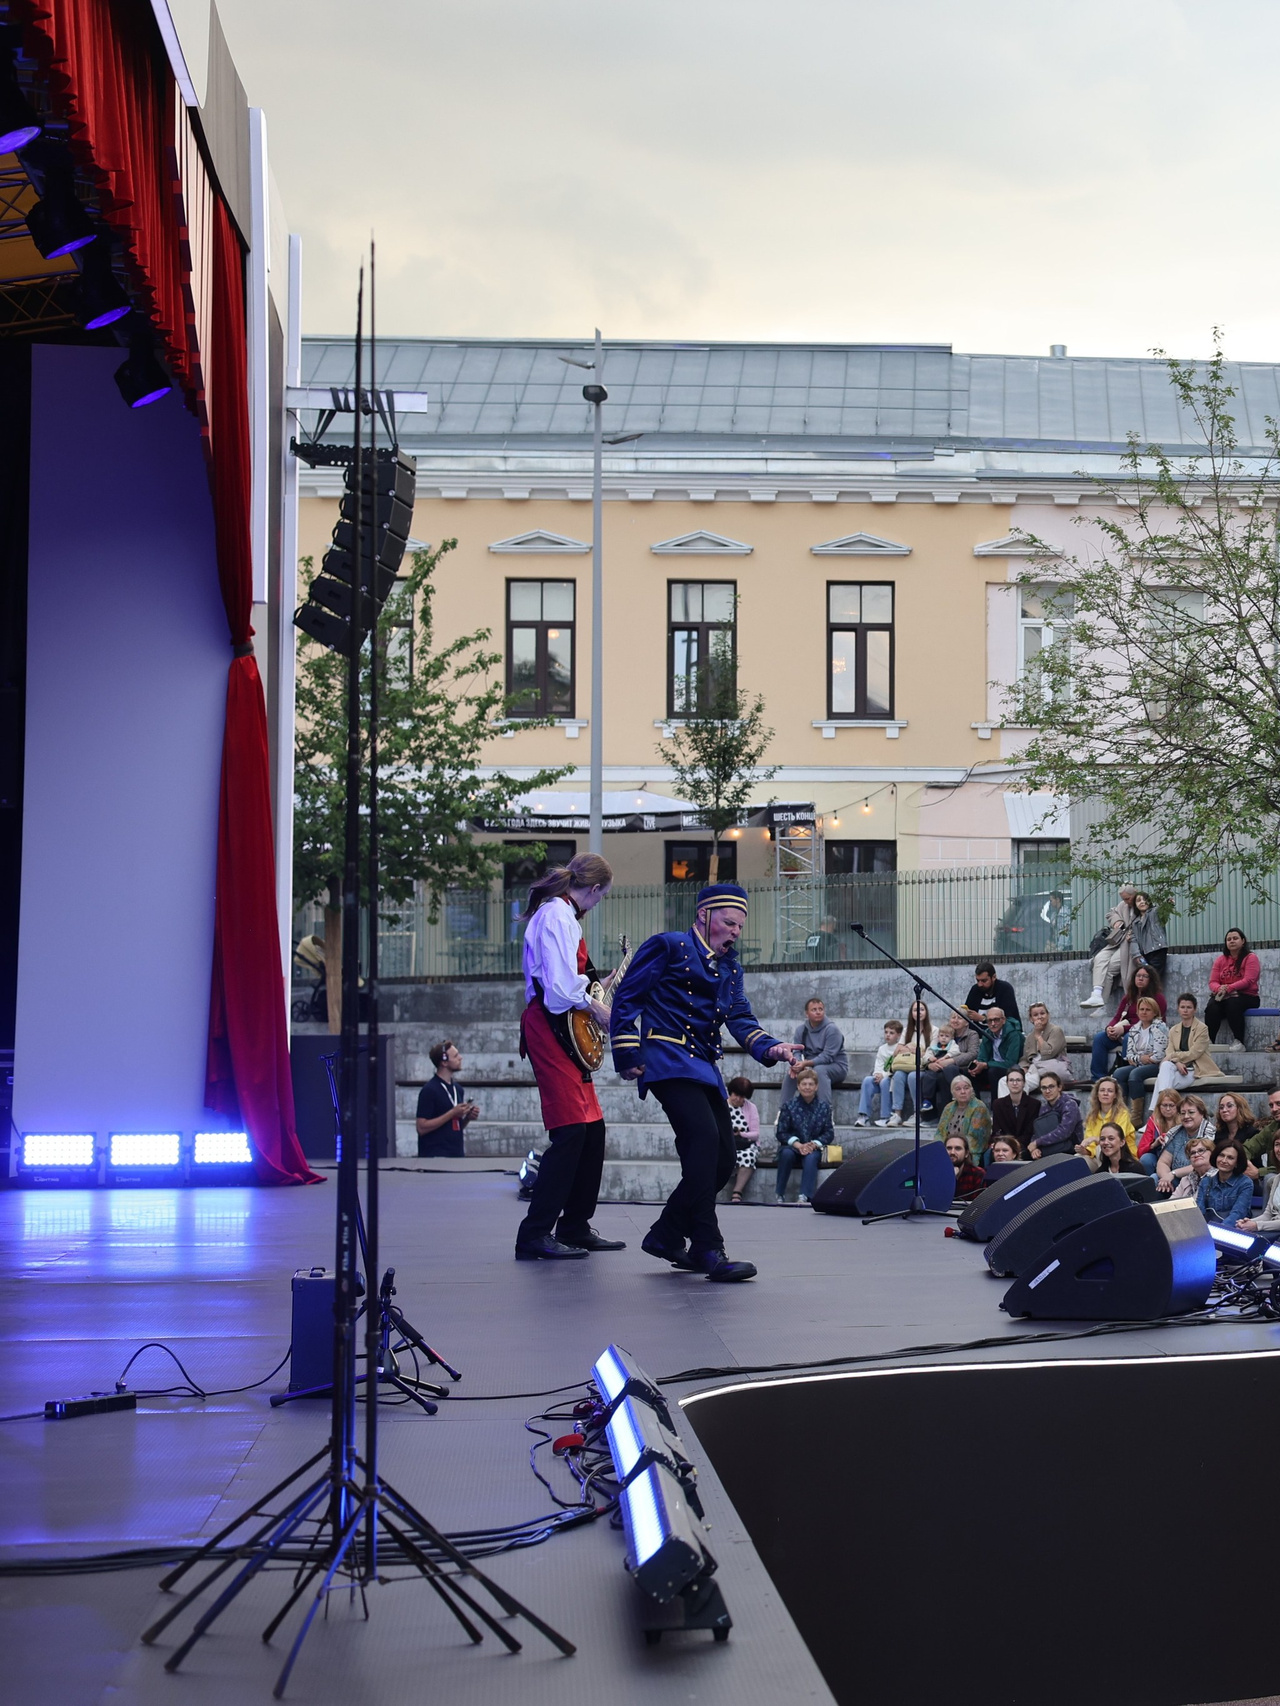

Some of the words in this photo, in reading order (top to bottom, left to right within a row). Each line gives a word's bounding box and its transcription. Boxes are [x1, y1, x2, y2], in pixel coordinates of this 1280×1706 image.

[773, 812, 796, 822] ШЕСТЬ
[507, 818, 525, 828] ГОДА
[525, 817, 547, 828] ЗДЕСЬ
[547, 818, 573, 828] ЗВУЧИТ
